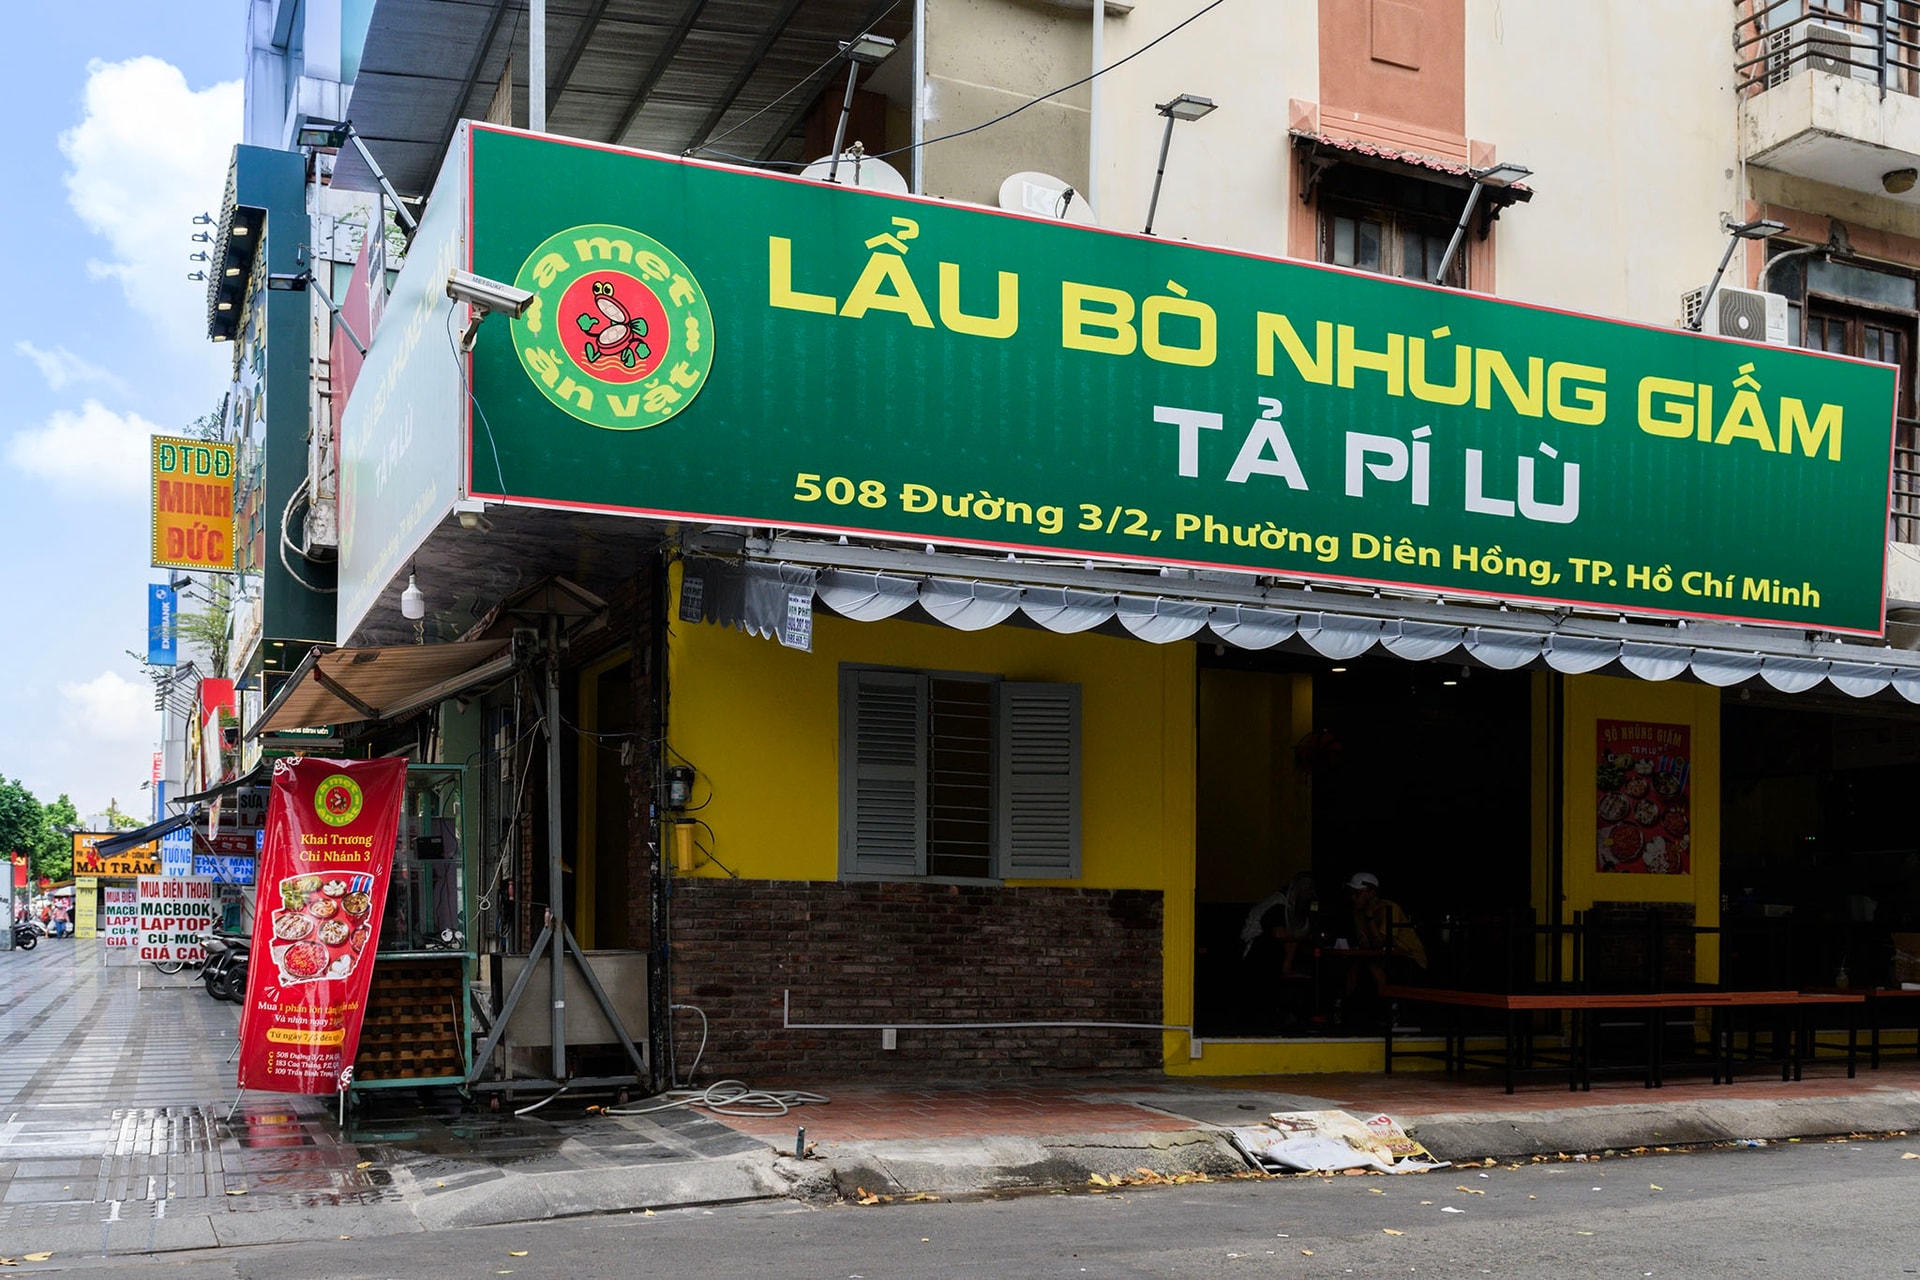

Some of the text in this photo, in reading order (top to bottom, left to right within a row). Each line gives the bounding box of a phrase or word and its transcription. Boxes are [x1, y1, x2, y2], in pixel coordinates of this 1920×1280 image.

[573, 236, 697, 308] mẹt
[769, 216, 1844, 462] LẨU BÒ NHÚNG GIẤM
[524, 346, 701, 418] ăn vật
[159, 443, 232, 478] ĐTDĐ
[1153, 396, 1581, 524] TẢ PÍ LÙ
[158, 479, 232, 518] MINH
[166, 520, 225, 563] ĐỨC
[793, 472, 1822, 609] 508 Đường 3/2, Phường Diên Hồng, TP. Hồ Chí Minh
[1657, 727, 1682, 747] GIẤM
[301, 833, 374, 848] Khai Trương
[300, 850, 371, 862] Chi Nhánh 3
[233, 866, 254, 876] PIN
[106, 891, 120, 903] MUA
[140, 878, 211, 903] MUA ĐIỆN THOẠI
[141, 903, 211, 917] MACBOOK
[141, 917, 211, 931] LAPTOP
[106, 936, 128, 946] GIÁ
[140, 945, 171, 960] GIÁ
[258, 1001, 277, 1011] Mua
[275, 1014, 286, 1023] Và
[310, 1018, 328, 1027] ngay
[270, 1030, 281, 1039] Từ
[283, 1031, 302, 1041] ngày
